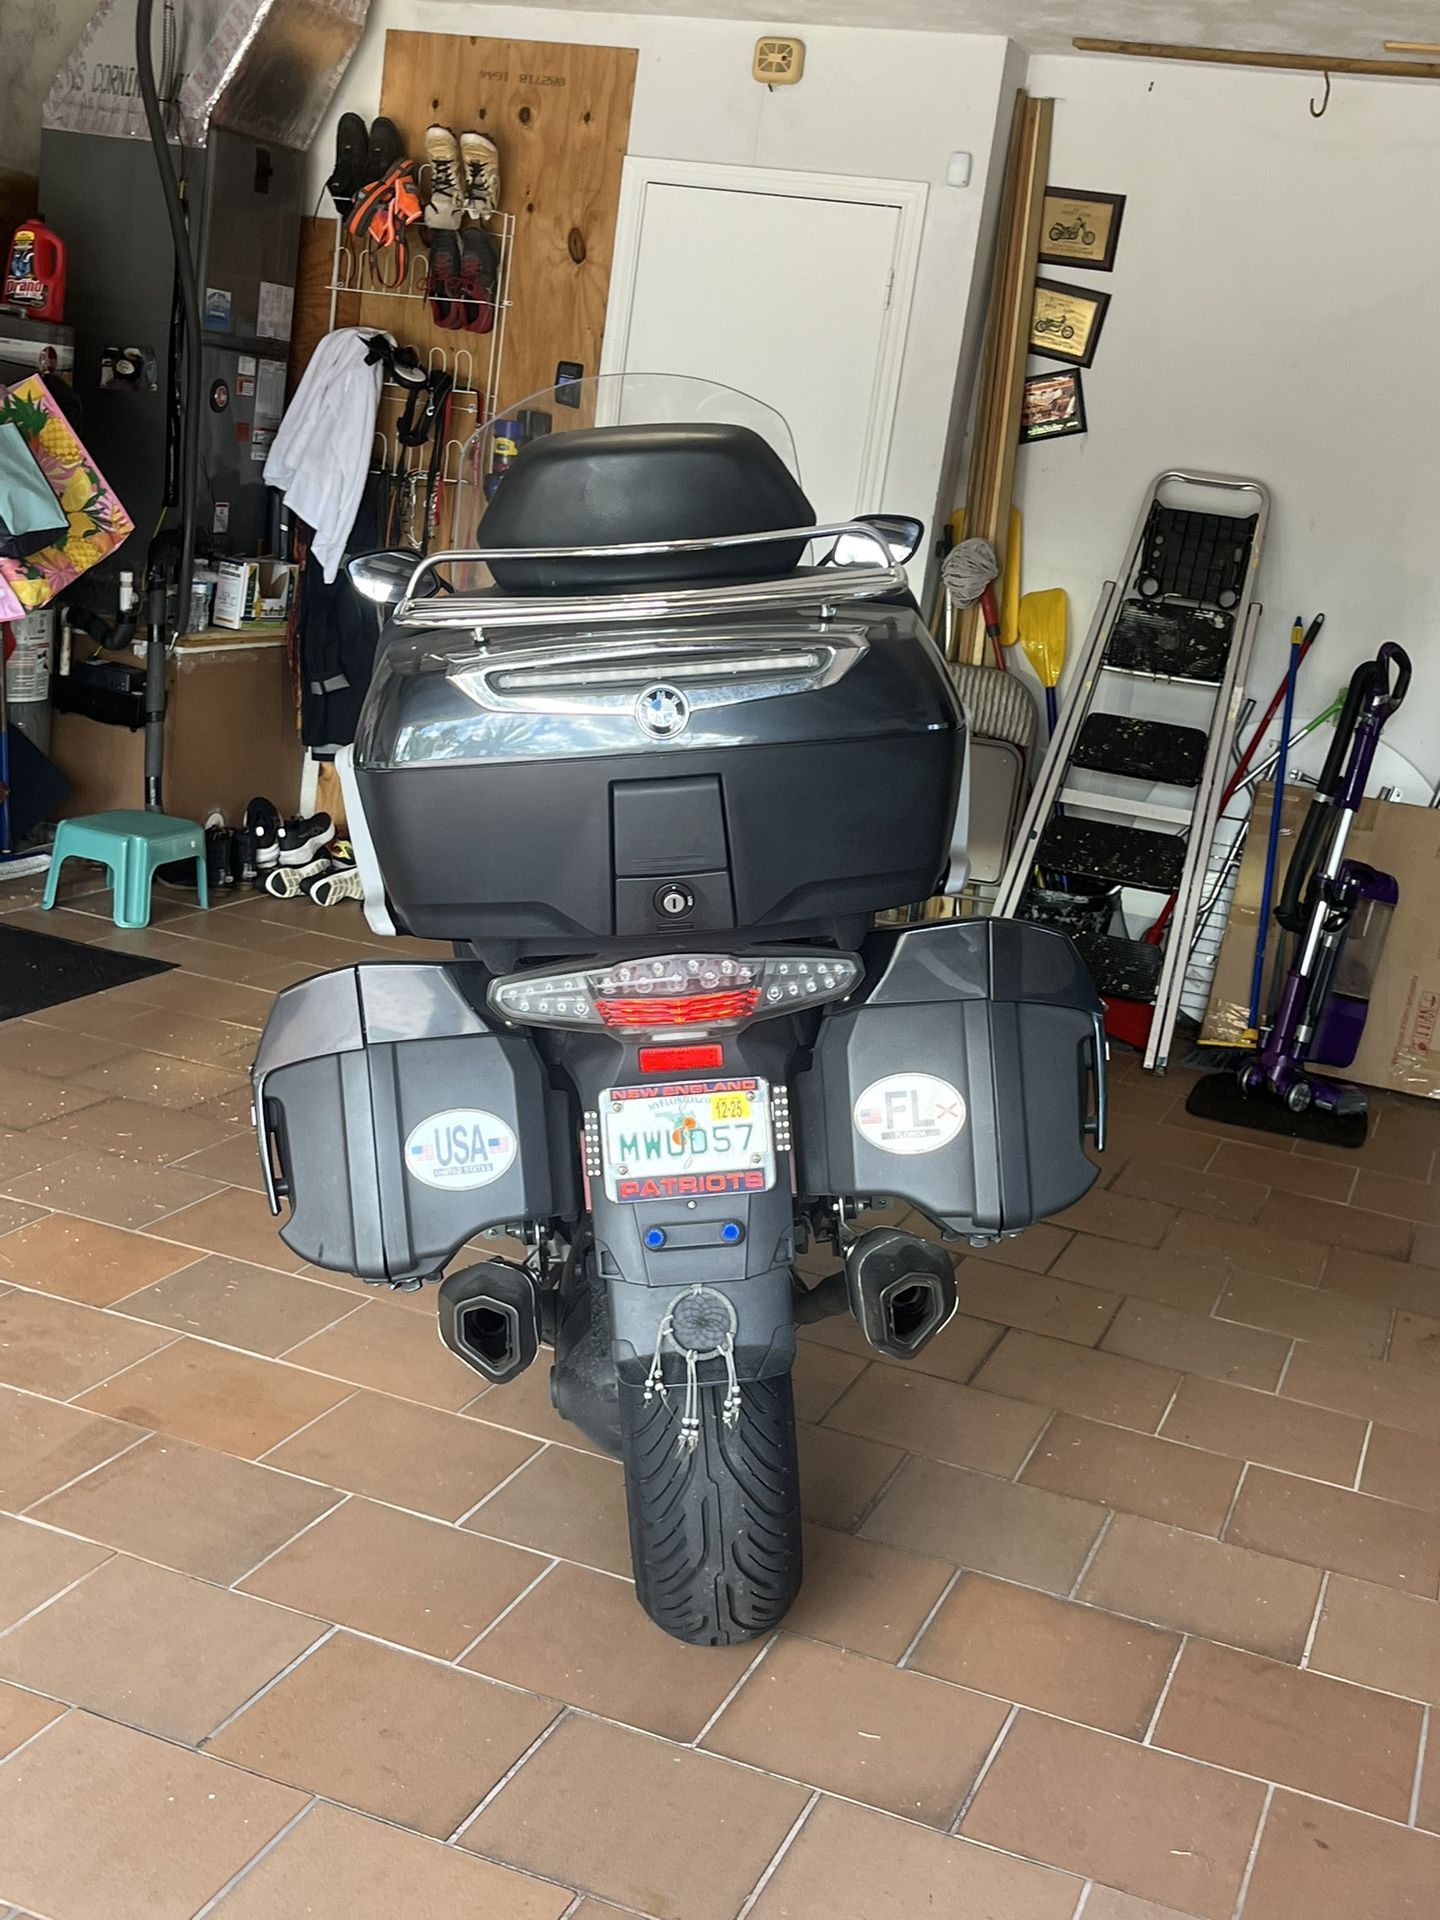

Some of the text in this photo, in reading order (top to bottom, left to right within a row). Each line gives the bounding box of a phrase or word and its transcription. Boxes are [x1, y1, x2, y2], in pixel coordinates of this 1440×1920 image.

[611, 1080, 756, 1100] NEW ENGLAND
[715, 1100, 743, 1119] 12-25
[885, 1089, 935, 1130] FL
[434, 1123, 489, 1167] USA
[619, 1170, 764, 1199] PATRIOTS
